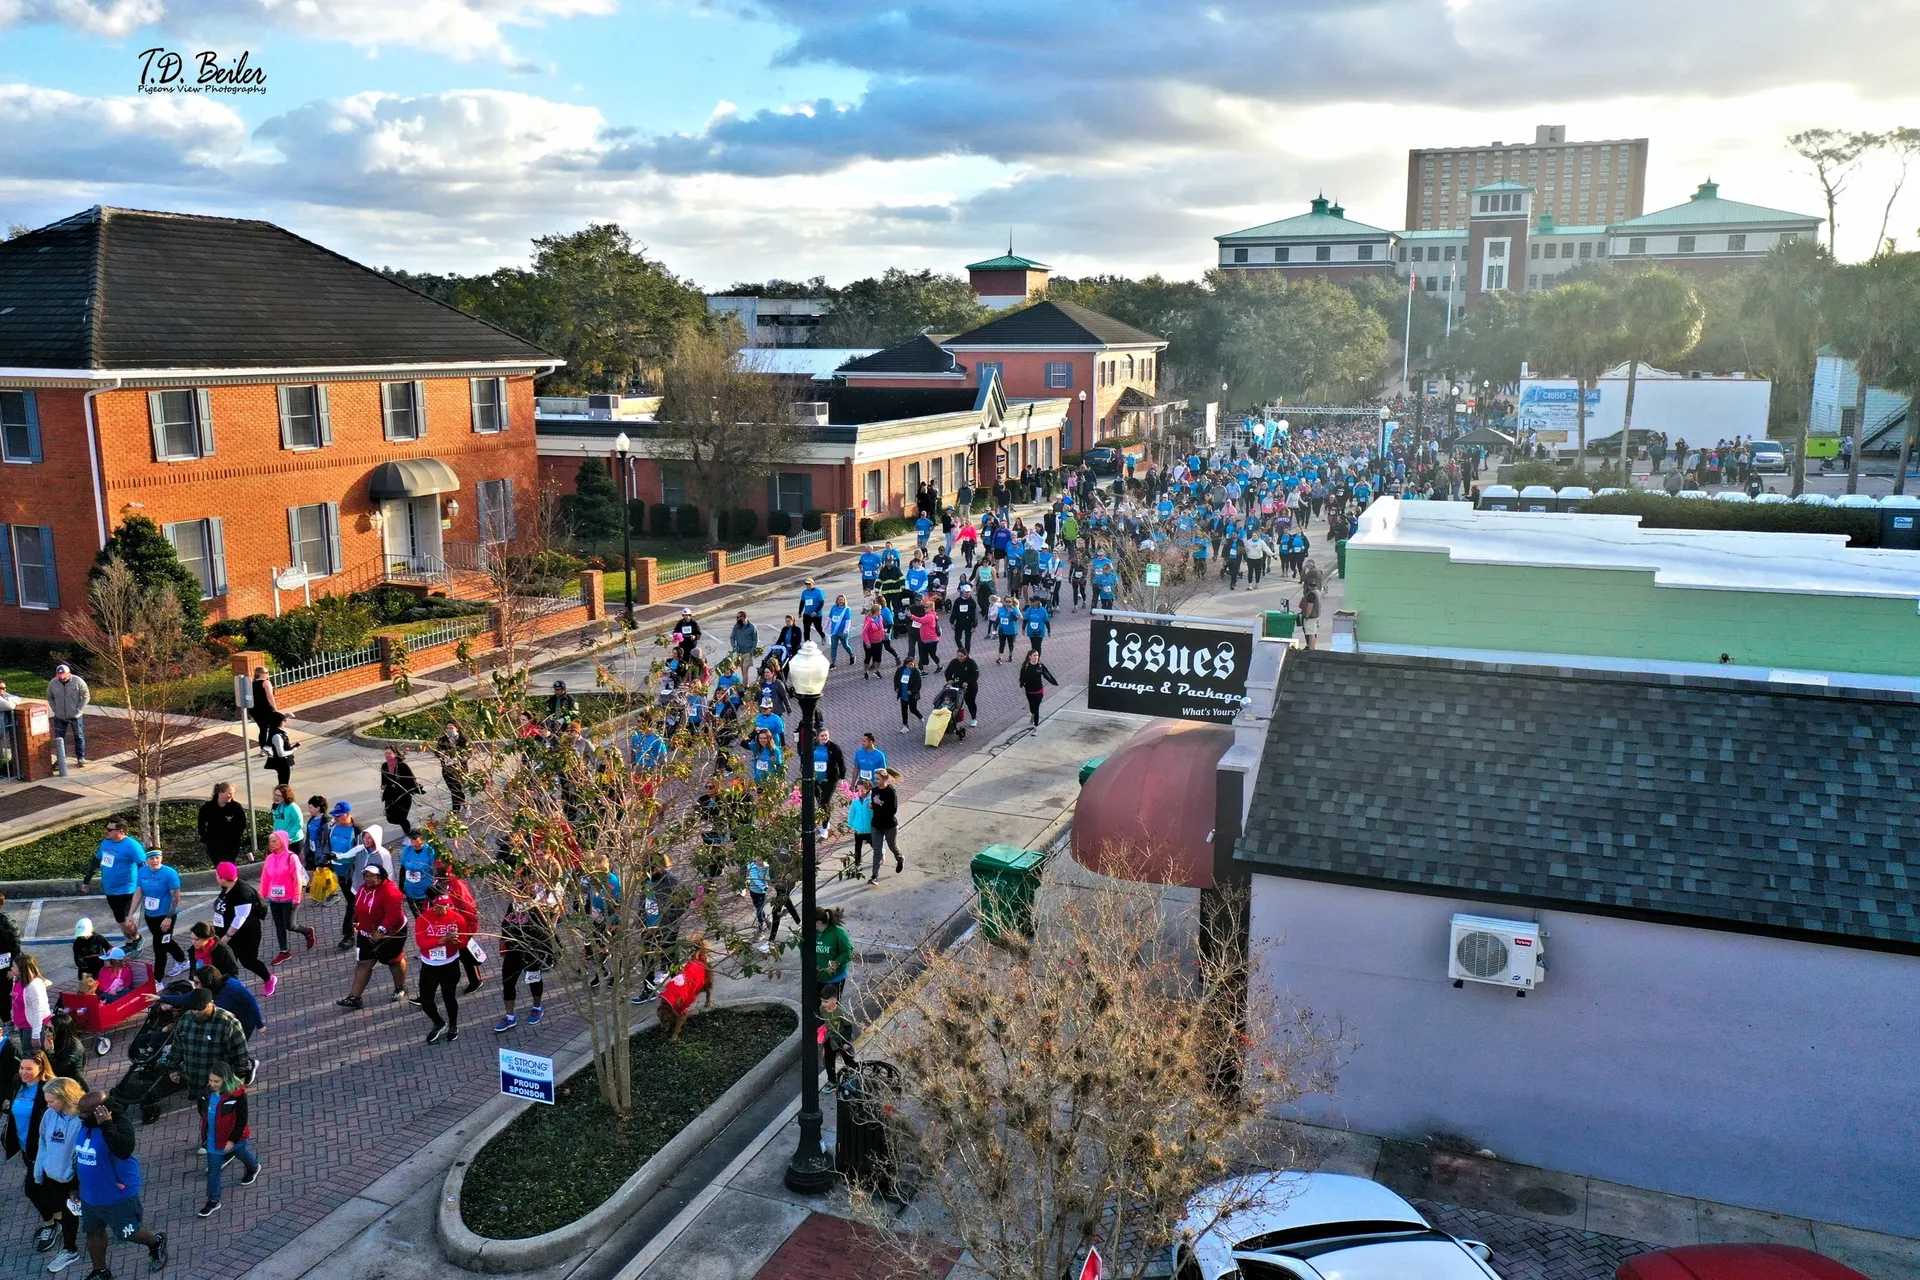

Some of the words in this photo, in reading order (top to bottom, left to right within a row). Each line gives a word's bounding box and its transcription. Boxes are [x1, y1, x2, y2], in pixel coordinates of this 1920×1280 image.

[1542, 391, 1567, 399] CRUISES
[1106, 628, 1235, 680] issues
[1096, 675, 1155, 695] Lounge
[1160, 681, 1172, 694] &
[1177, 682, 1244, 704] Package
[1182, 707, 1211, 717] What's
[1212, 708, 1241, 717] Yours?
[514, 1057, 548, 1072] STRONG
[513, 1078, 540, 1090] PROUD
[509, 1085, 545, 1099] SPONSOR
